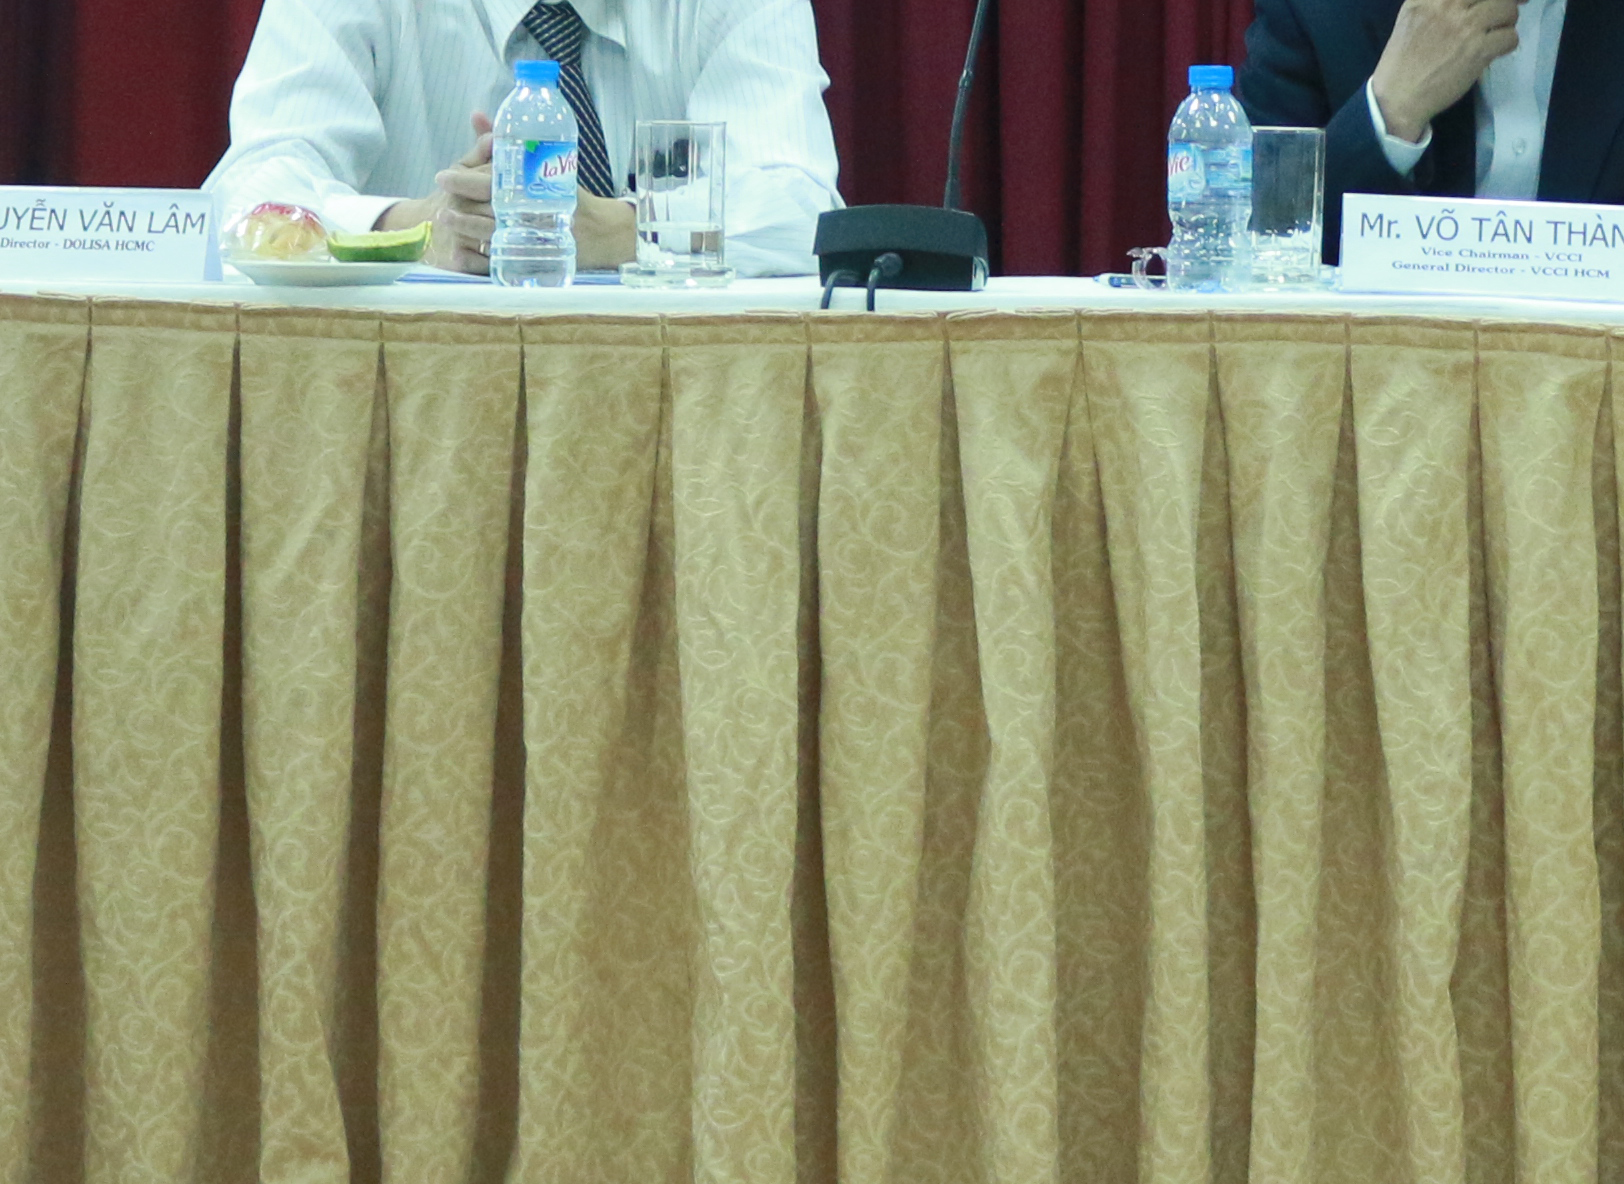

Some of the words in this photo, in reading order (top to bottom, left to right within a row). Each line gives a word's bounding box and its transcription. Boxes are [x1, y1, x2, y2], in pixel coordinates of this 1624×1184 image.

[79, 201, 136, 233] VĂN
[147, 203, 206, 234] LÂM
[1360, 212, 1401, 238] Mr.
[1415, 208, 1459, 241] VÕ
[0, 237, 50, 249] Director
[63, 238, 111, 250] DOLISA
[115, 240, 156, 251] HCMC
[1421, 246, 1453, 257] Vice
[1458, 248, 1530, 260] Chairman
[1544, 252, 1583, 263] VCCI
[1391, 260, 1450, 272] General
[1454, 262, 1516, 275] Director
[1531, 266, 1568, 276] VCCI
[1574, 268, 1610, 279] HCM
